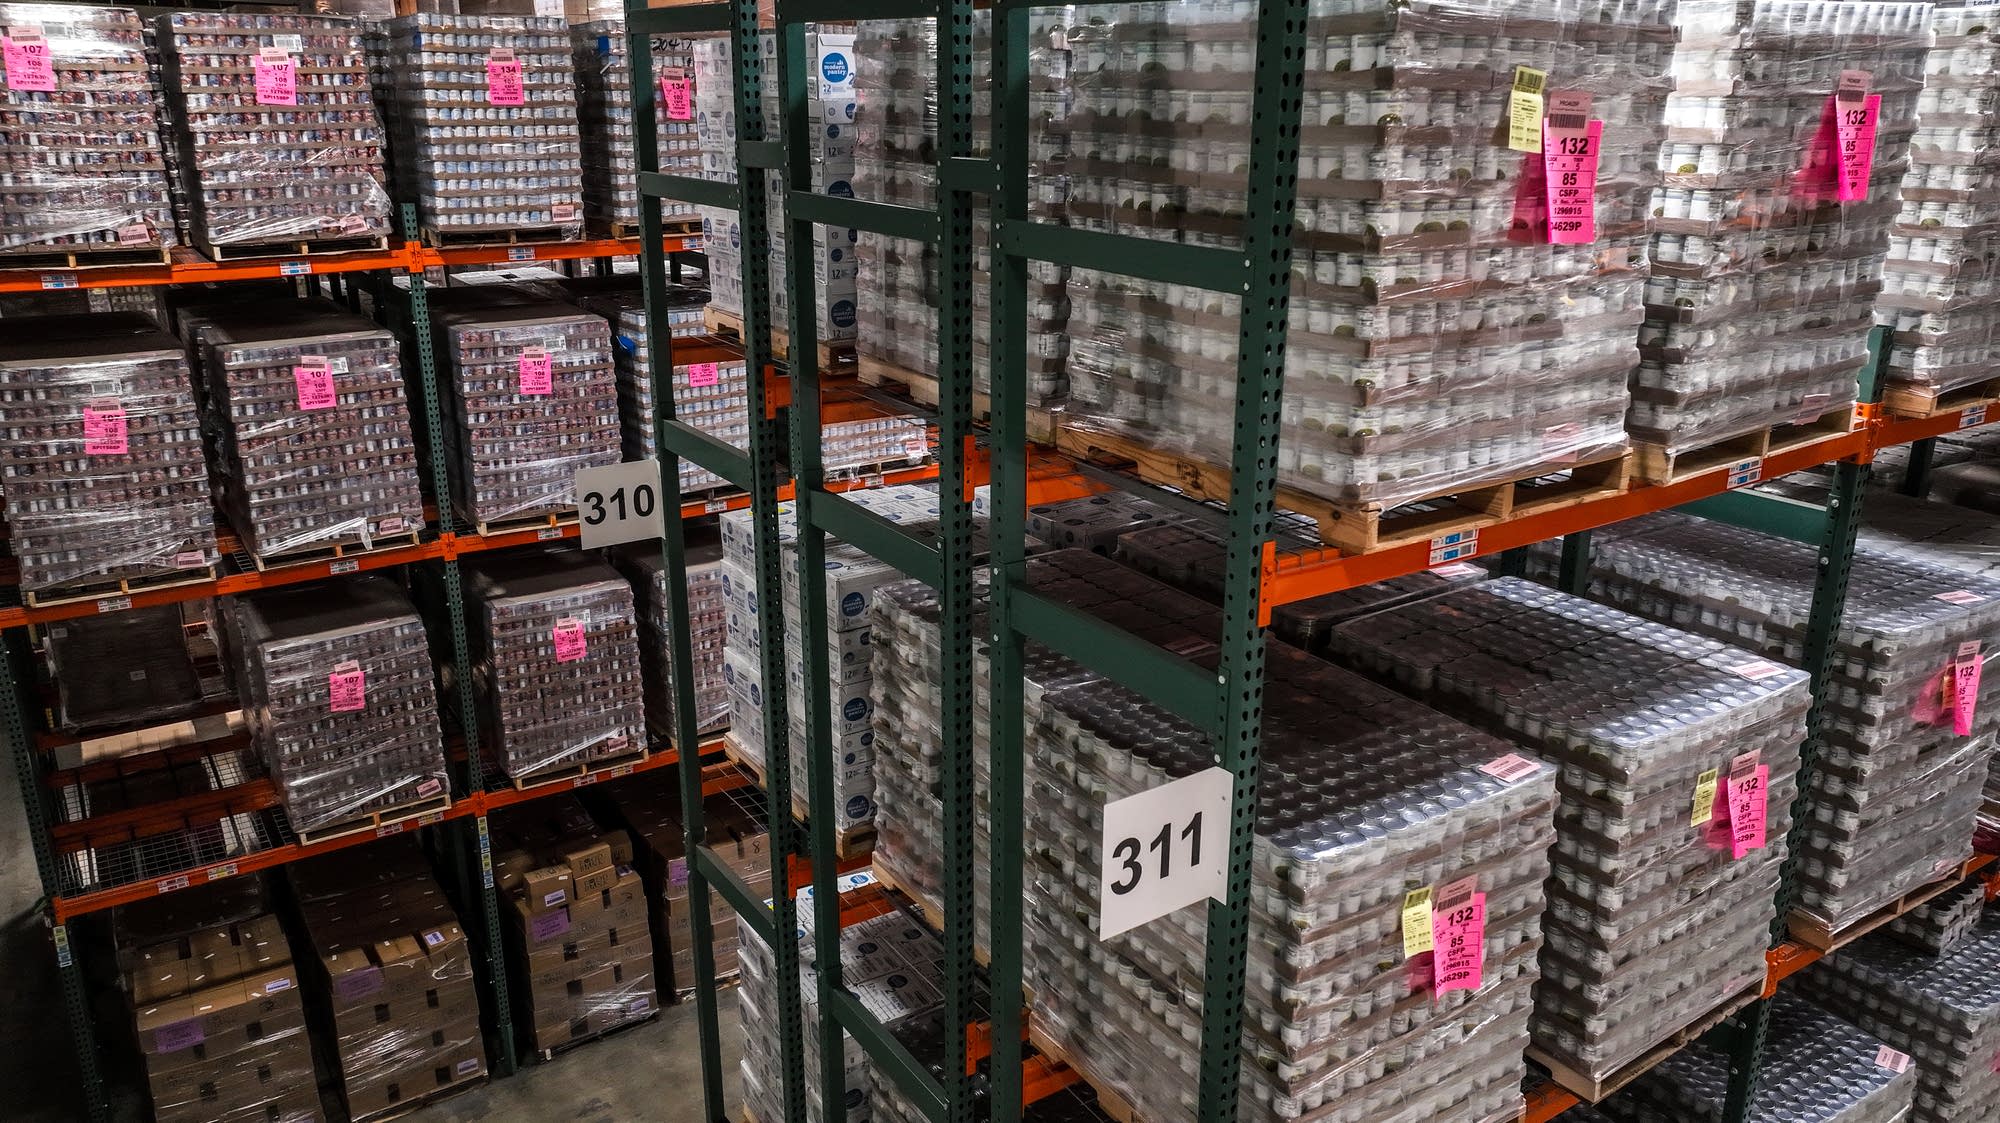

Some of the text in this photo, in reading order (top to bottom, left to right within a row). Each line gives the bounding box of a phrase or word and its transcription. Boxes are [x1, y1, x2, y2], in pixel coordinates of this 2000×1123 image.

[22, 45, 42, 53] 107
[1845, 110, 1867, 124] 132
[1560, 137, 1588, 154] 132
[1845, 141, 1856, 151] 85
[1575, 163, 1580, 171] 5
[1562, 173, 1577, 186] 85
[1559, 189, 1579, 197] CSFP
[583, 484, 654, 525] 310
[1960, 666, 1974, 677] 132
[344, 676, 359, 684] 107
[1738, 778, 1758, 793] 132
[1740, 803, 1750, 813] 85
[1110, 811, 1203, 896] 311
[1448, 907, 1473, 927] 132
[1450, 936, 1463, 948] 85
[1447, 947, 1465, 957] CSFP
